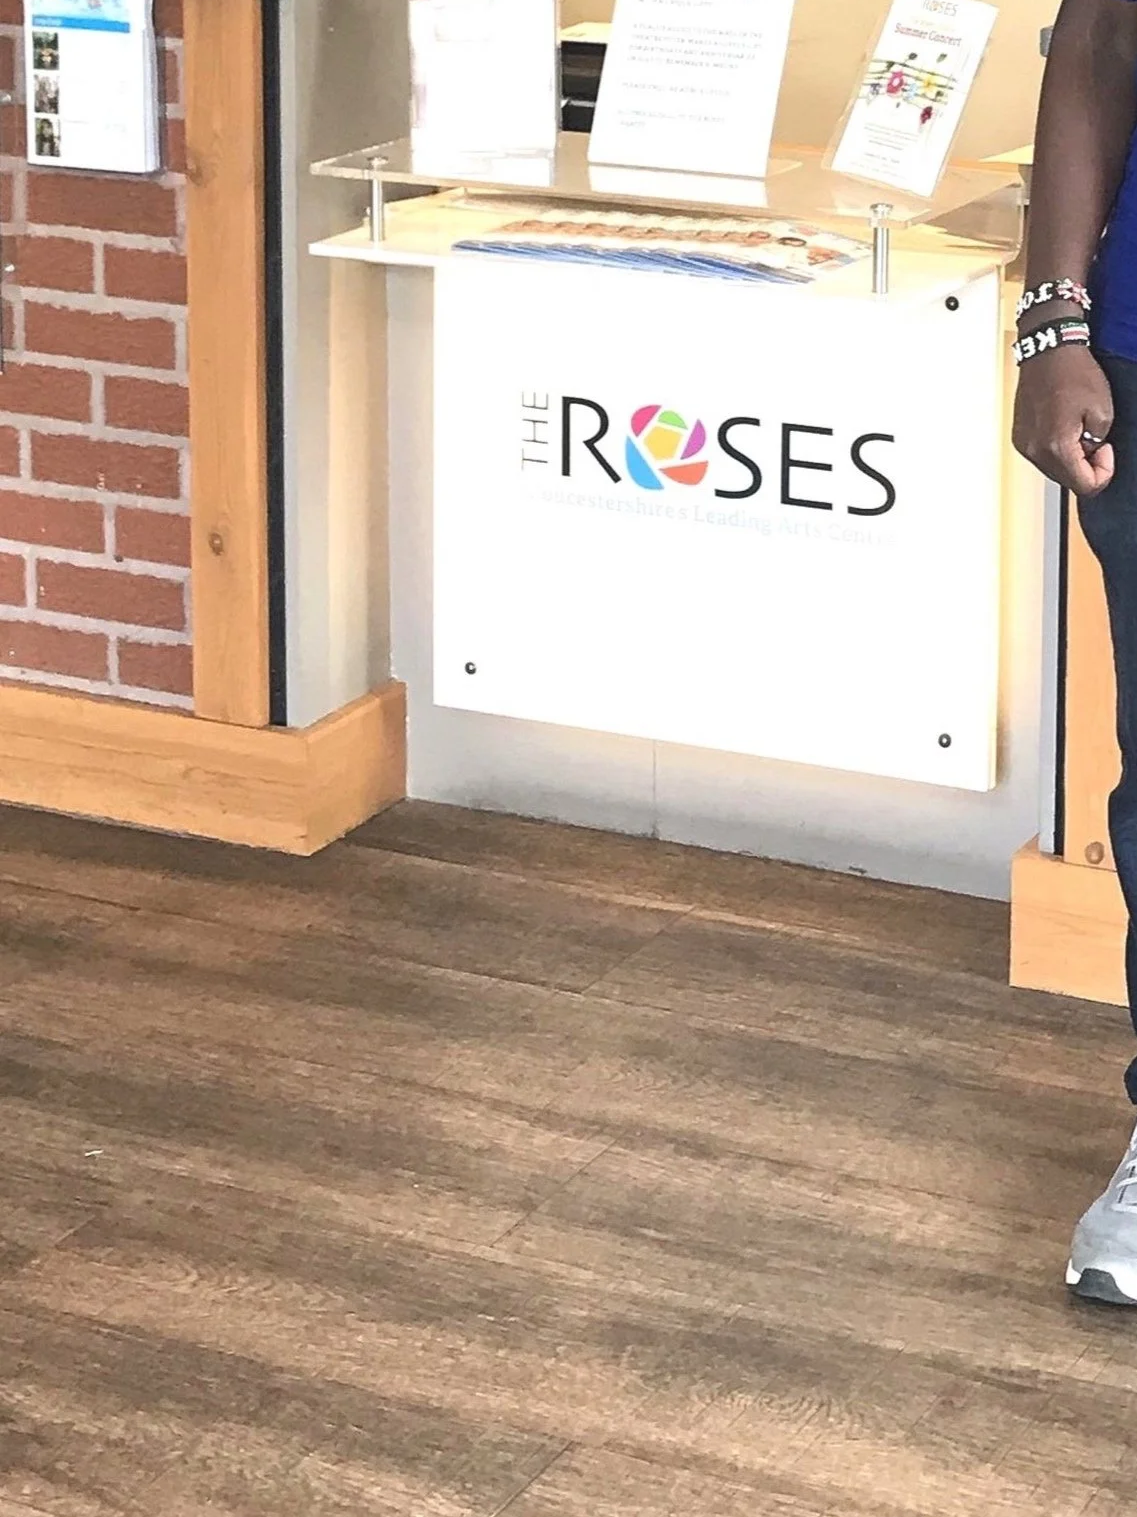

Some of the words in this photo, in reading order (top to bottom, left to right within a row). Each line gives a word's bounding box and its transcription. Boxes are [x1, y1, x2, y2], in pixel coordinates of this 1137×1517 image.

[894, 22, 930, 40] Summer
[928, 29, 963, 48] Concert
[521, 390, 550, 473] THE
[561, 395, 898, 518] ROSES
[694, 504, 774, 538] Leading
